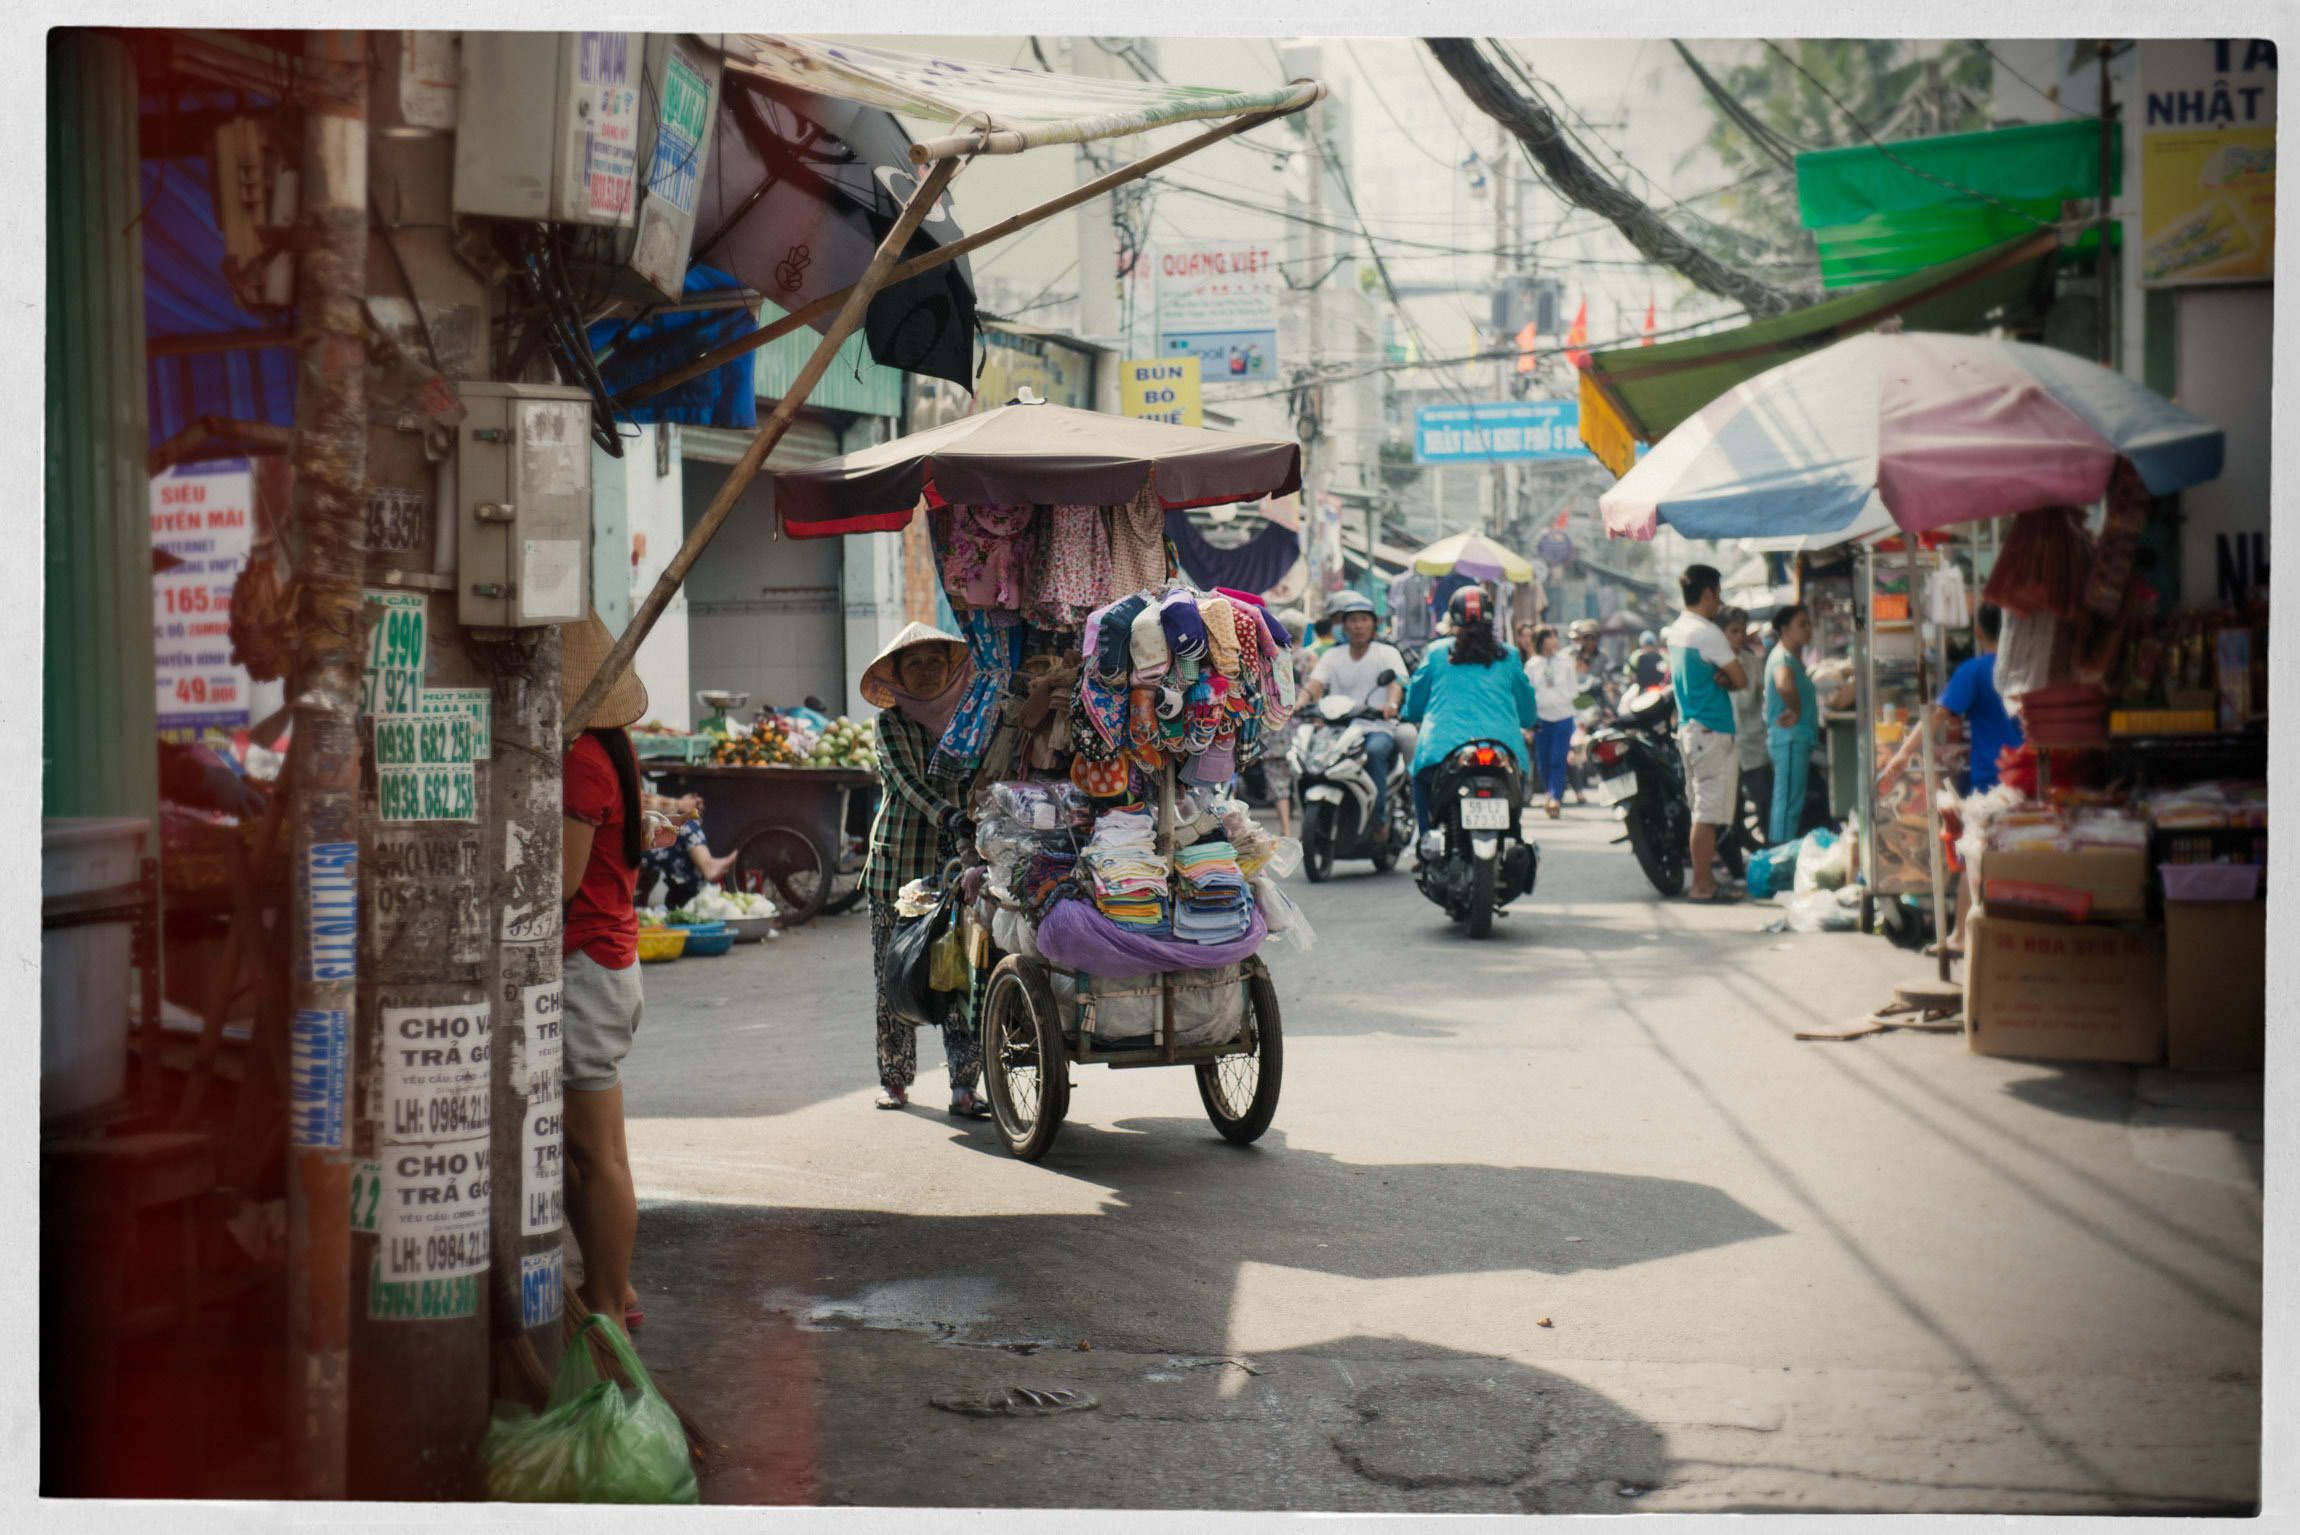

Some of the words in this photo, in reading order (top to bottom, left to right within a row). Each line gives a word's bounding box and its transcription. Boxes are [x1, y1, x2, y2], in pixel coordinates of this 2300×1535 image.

[2146, 79, 2265, 130] NHẬT
[1162, 251, 1226, 276] QUANG
[1230, 246, 1270, 279] VIỆT
[400, 1017, 469, 1040] CHO
[536, 1019, 562, 1040] TR
[400, 1040, 462, 1067] TRẢ
[395, 1099, 424, 1134] LH:
[397, 1153, 468, 1178] CHO
[398, 1178, 460, 1206] TRẢ
[391, 1236, 421, 1274] LH:
